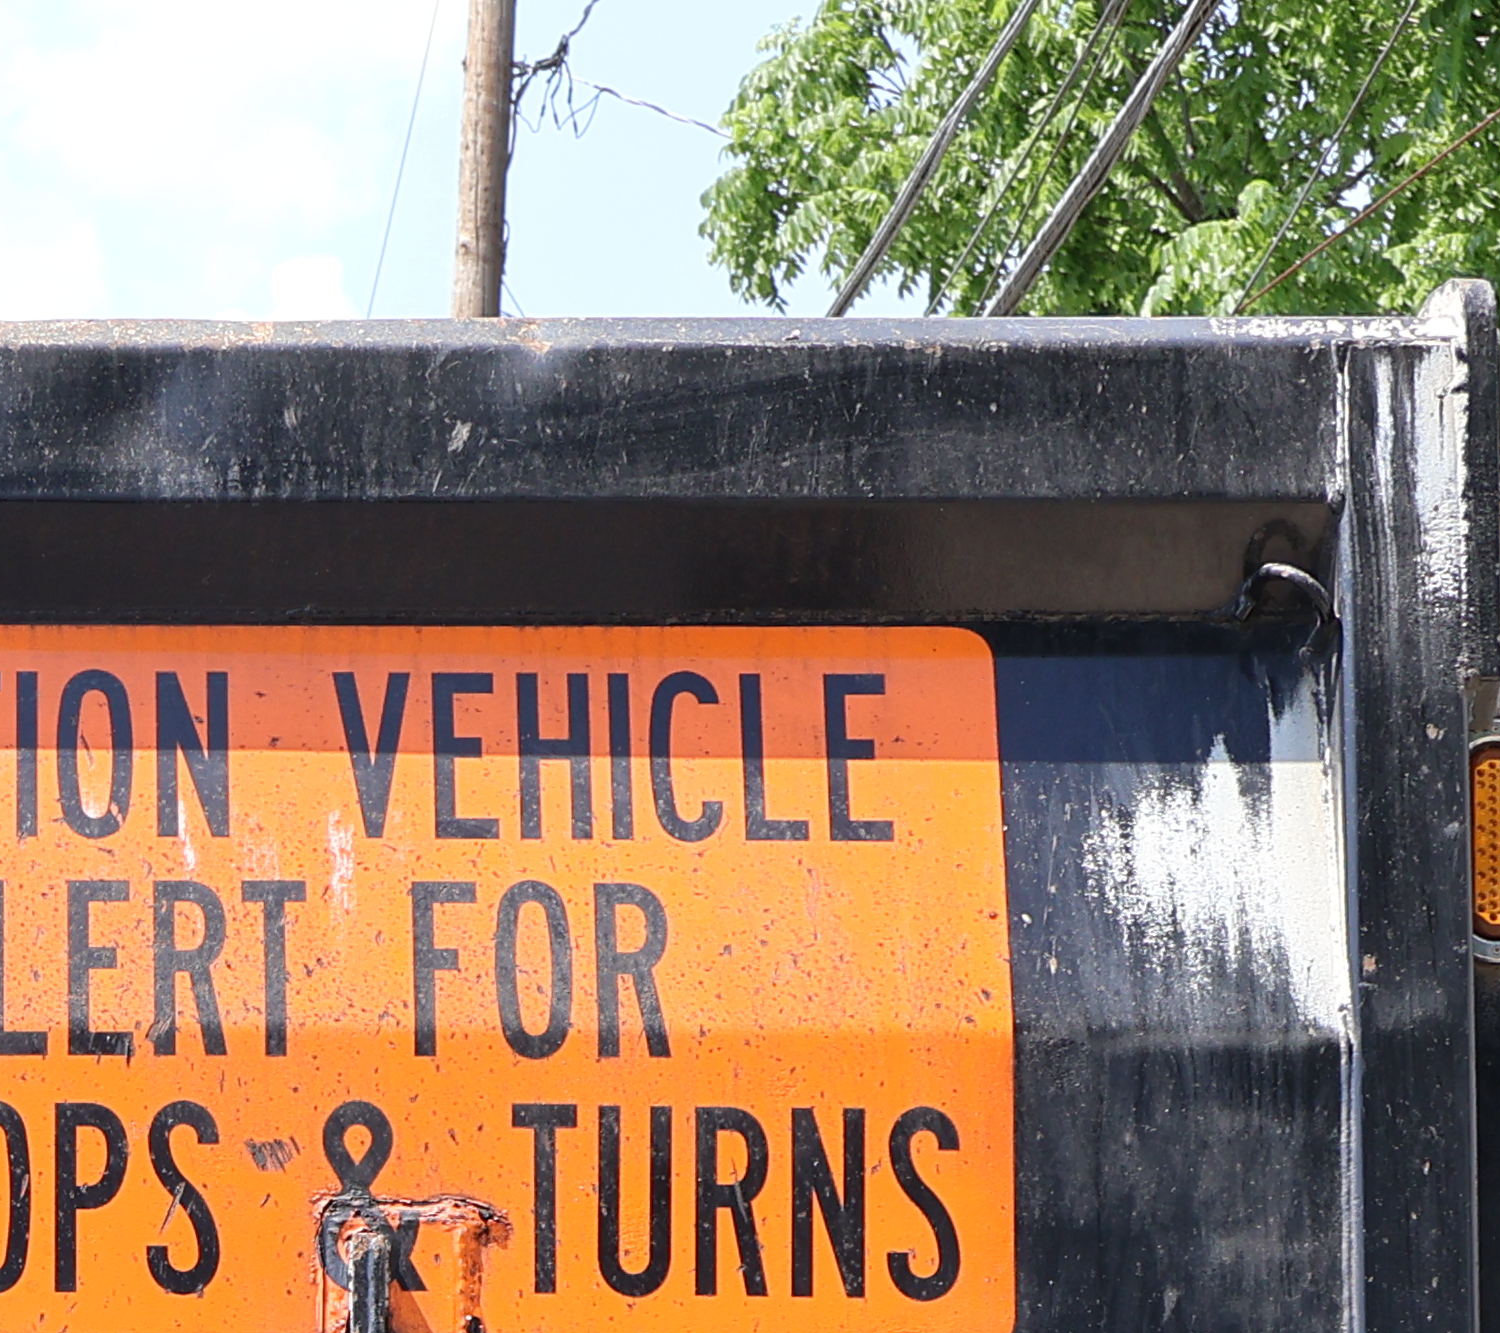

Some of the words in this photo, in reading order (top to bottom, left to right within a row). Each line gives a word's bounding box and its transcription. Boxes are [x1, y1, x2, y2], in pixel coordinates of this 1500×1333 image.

[331, 670, 895, 843] VEHICLE
[409, 880, 672, 1061] FOR
[316, 1099, 429, 1293] &
[511, 1103, 962, 1302] TURNS
